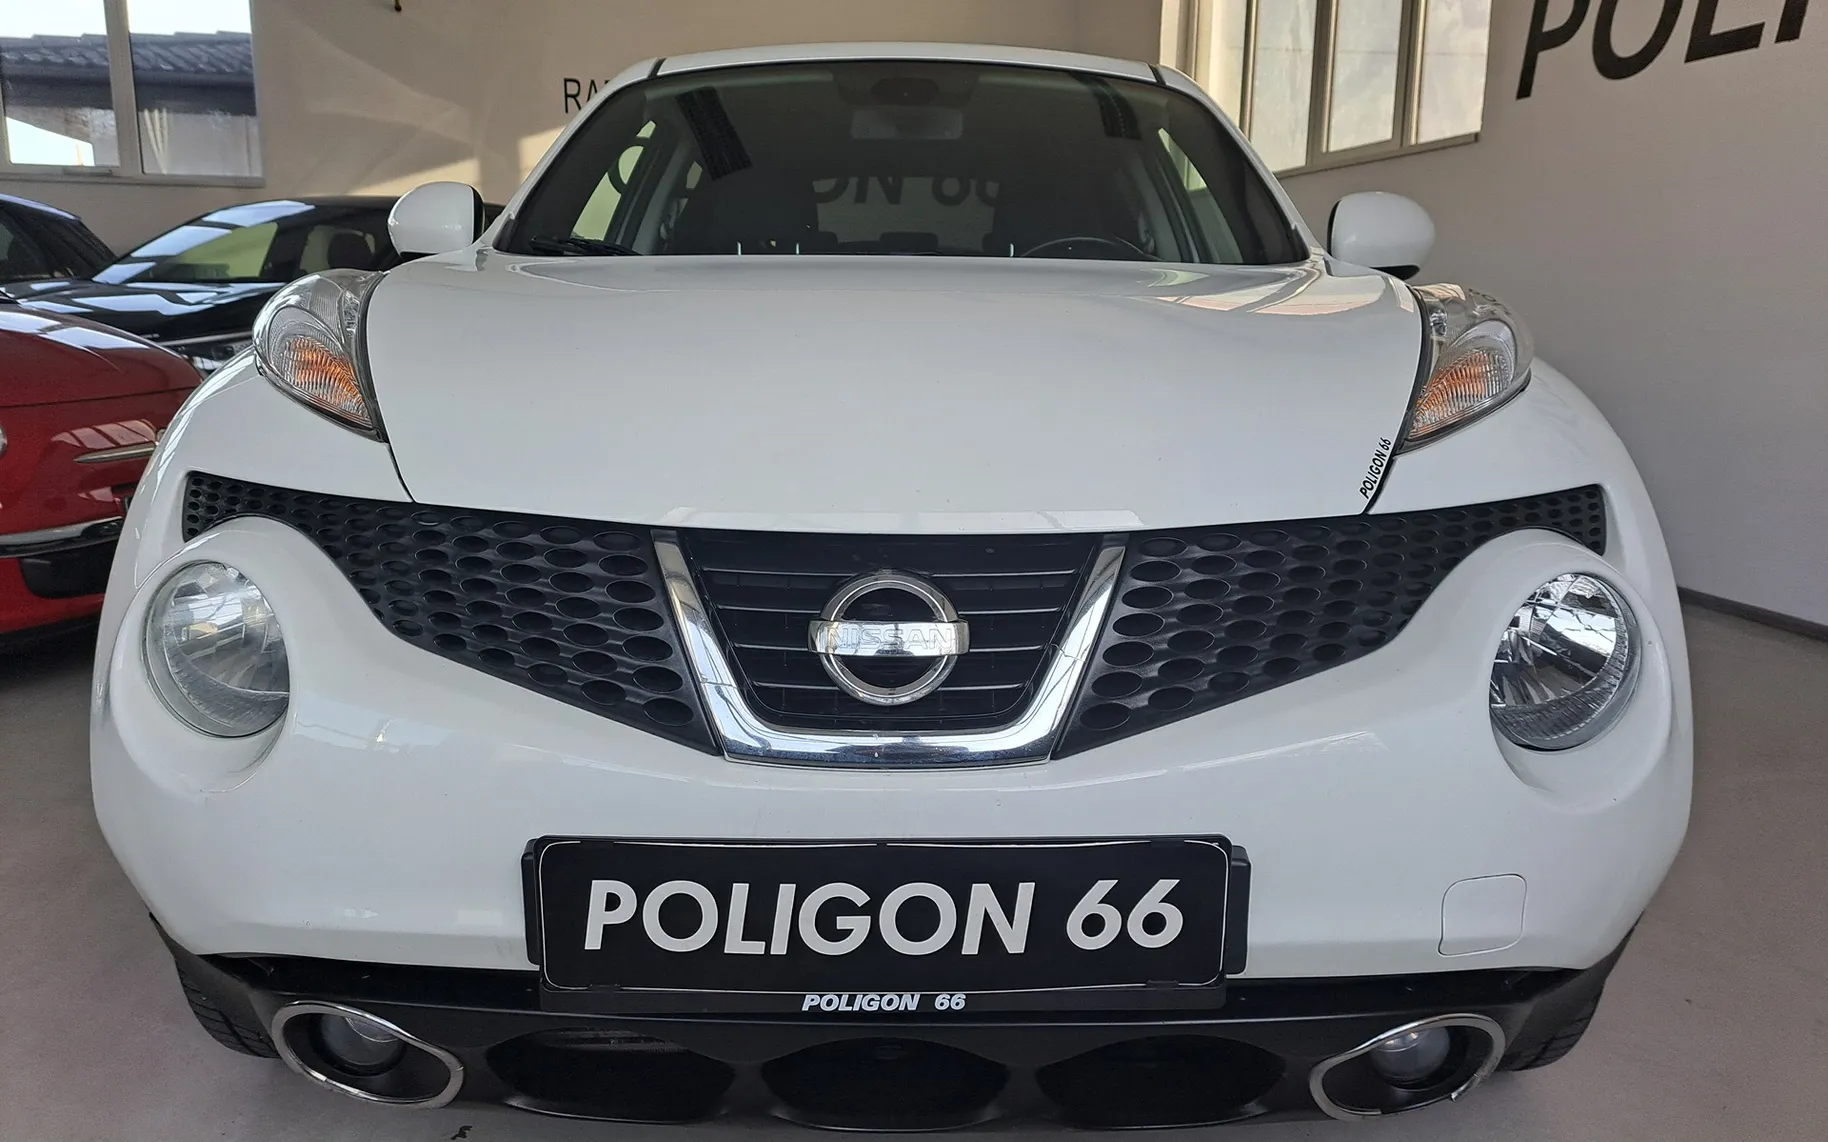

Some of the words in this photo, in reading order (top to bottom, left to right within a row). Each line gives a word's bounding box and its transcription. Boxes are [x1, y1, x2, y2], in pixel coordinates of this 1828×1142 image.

[564, 78, 610, 114] RA
[1359, 449, 1387, 500] POLIGON
[1379, 437, 1392, 451] 66
[820, 625, 956, 650] NISSAN
[583, 879, 1035, 957] POLIGON
[1066, 878, 1184, 950] 66
[801, 993, 919, 1012] POLIGON
[934, 993, 966, 1012] 66
